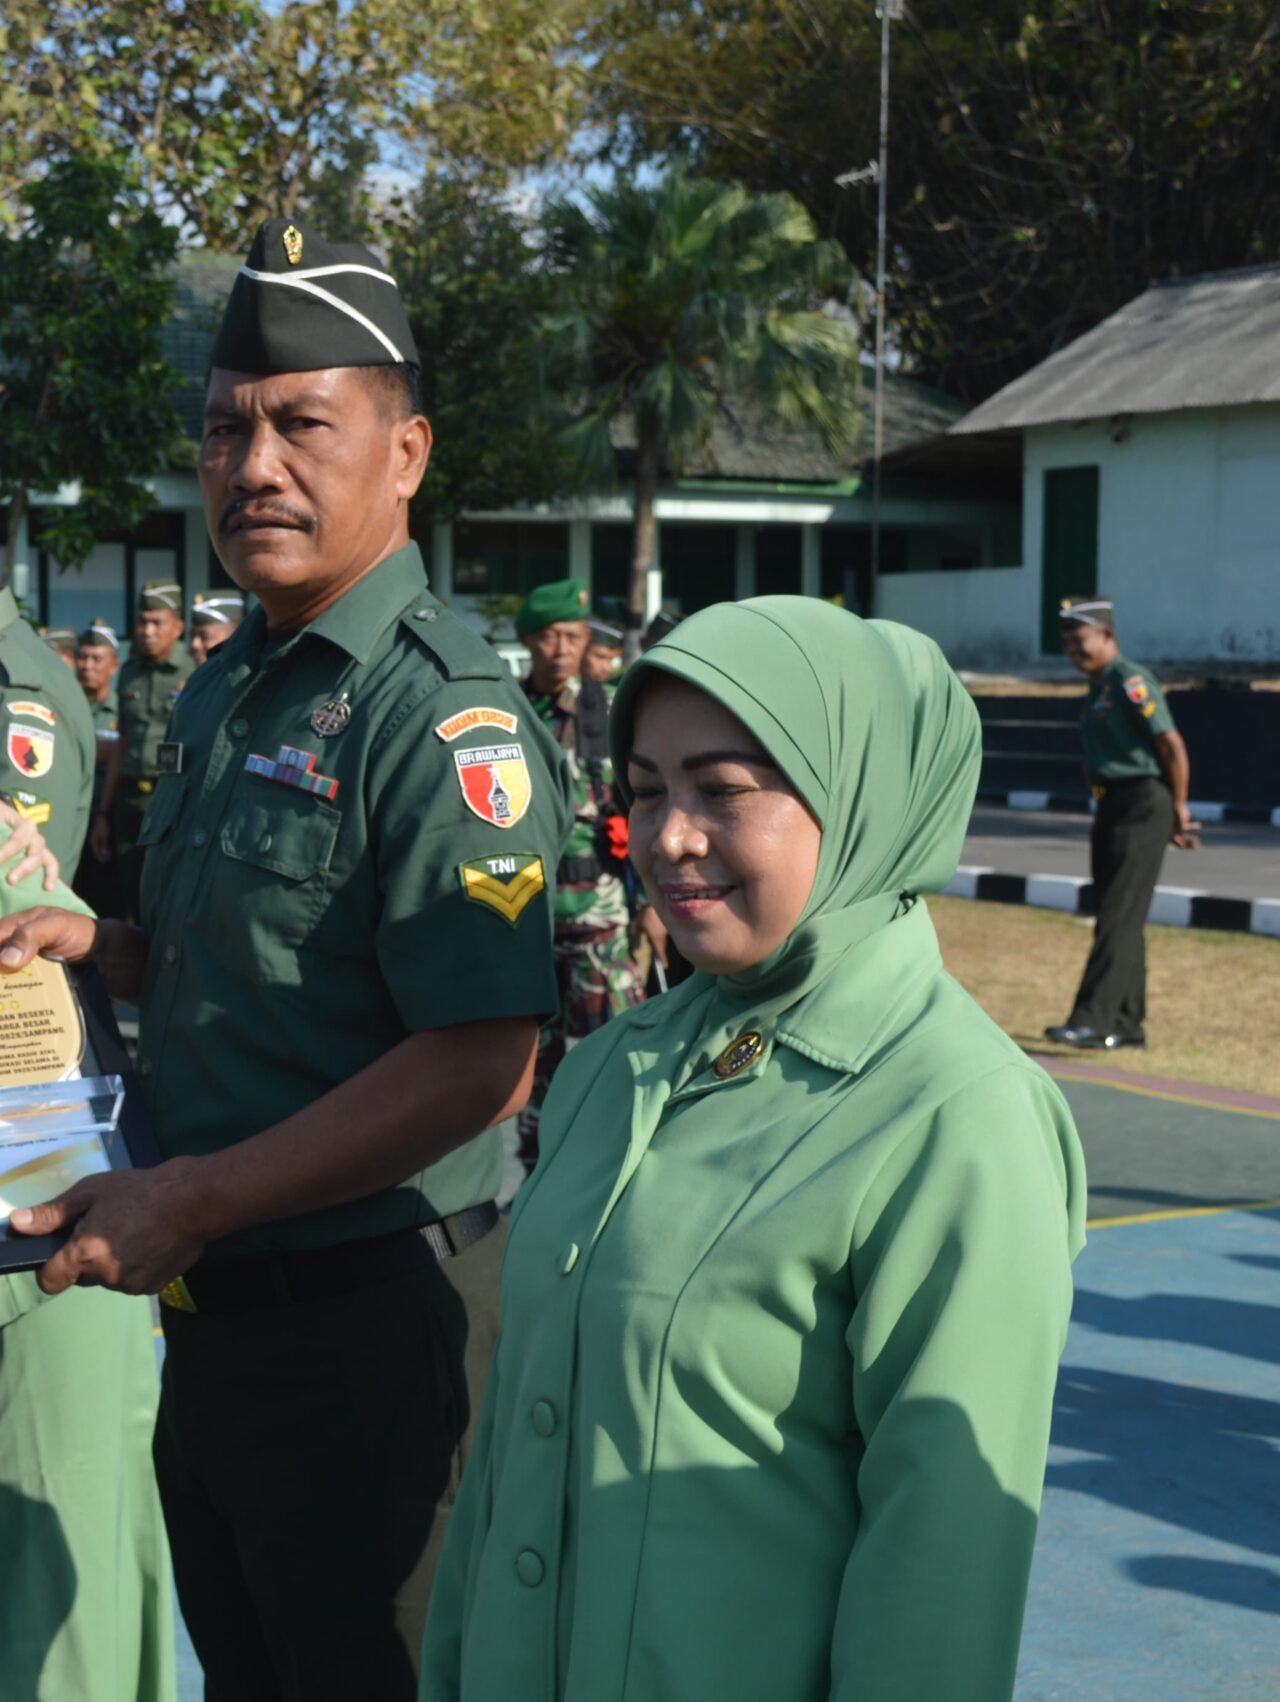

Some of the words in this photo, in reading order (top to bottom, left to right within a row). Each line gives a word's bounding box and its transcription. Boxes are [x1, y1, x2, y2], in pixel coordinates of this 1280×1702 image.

[439, 711, 478, 738] KODIM
[482, 711, 514, 730] 0828
[458, 747, 520, 765] BRAWIJAYA
[486, 858, 516, 874] TNI
[18, 1009, 55, 1019] BESERTA
[23, 1019, 50, 1029] BESAR
[17, 1051, 38, 1059] KASIH
[39, 1049, 57, 1057] ATAS
[23, 1058, 50, 1067] SELAMA
